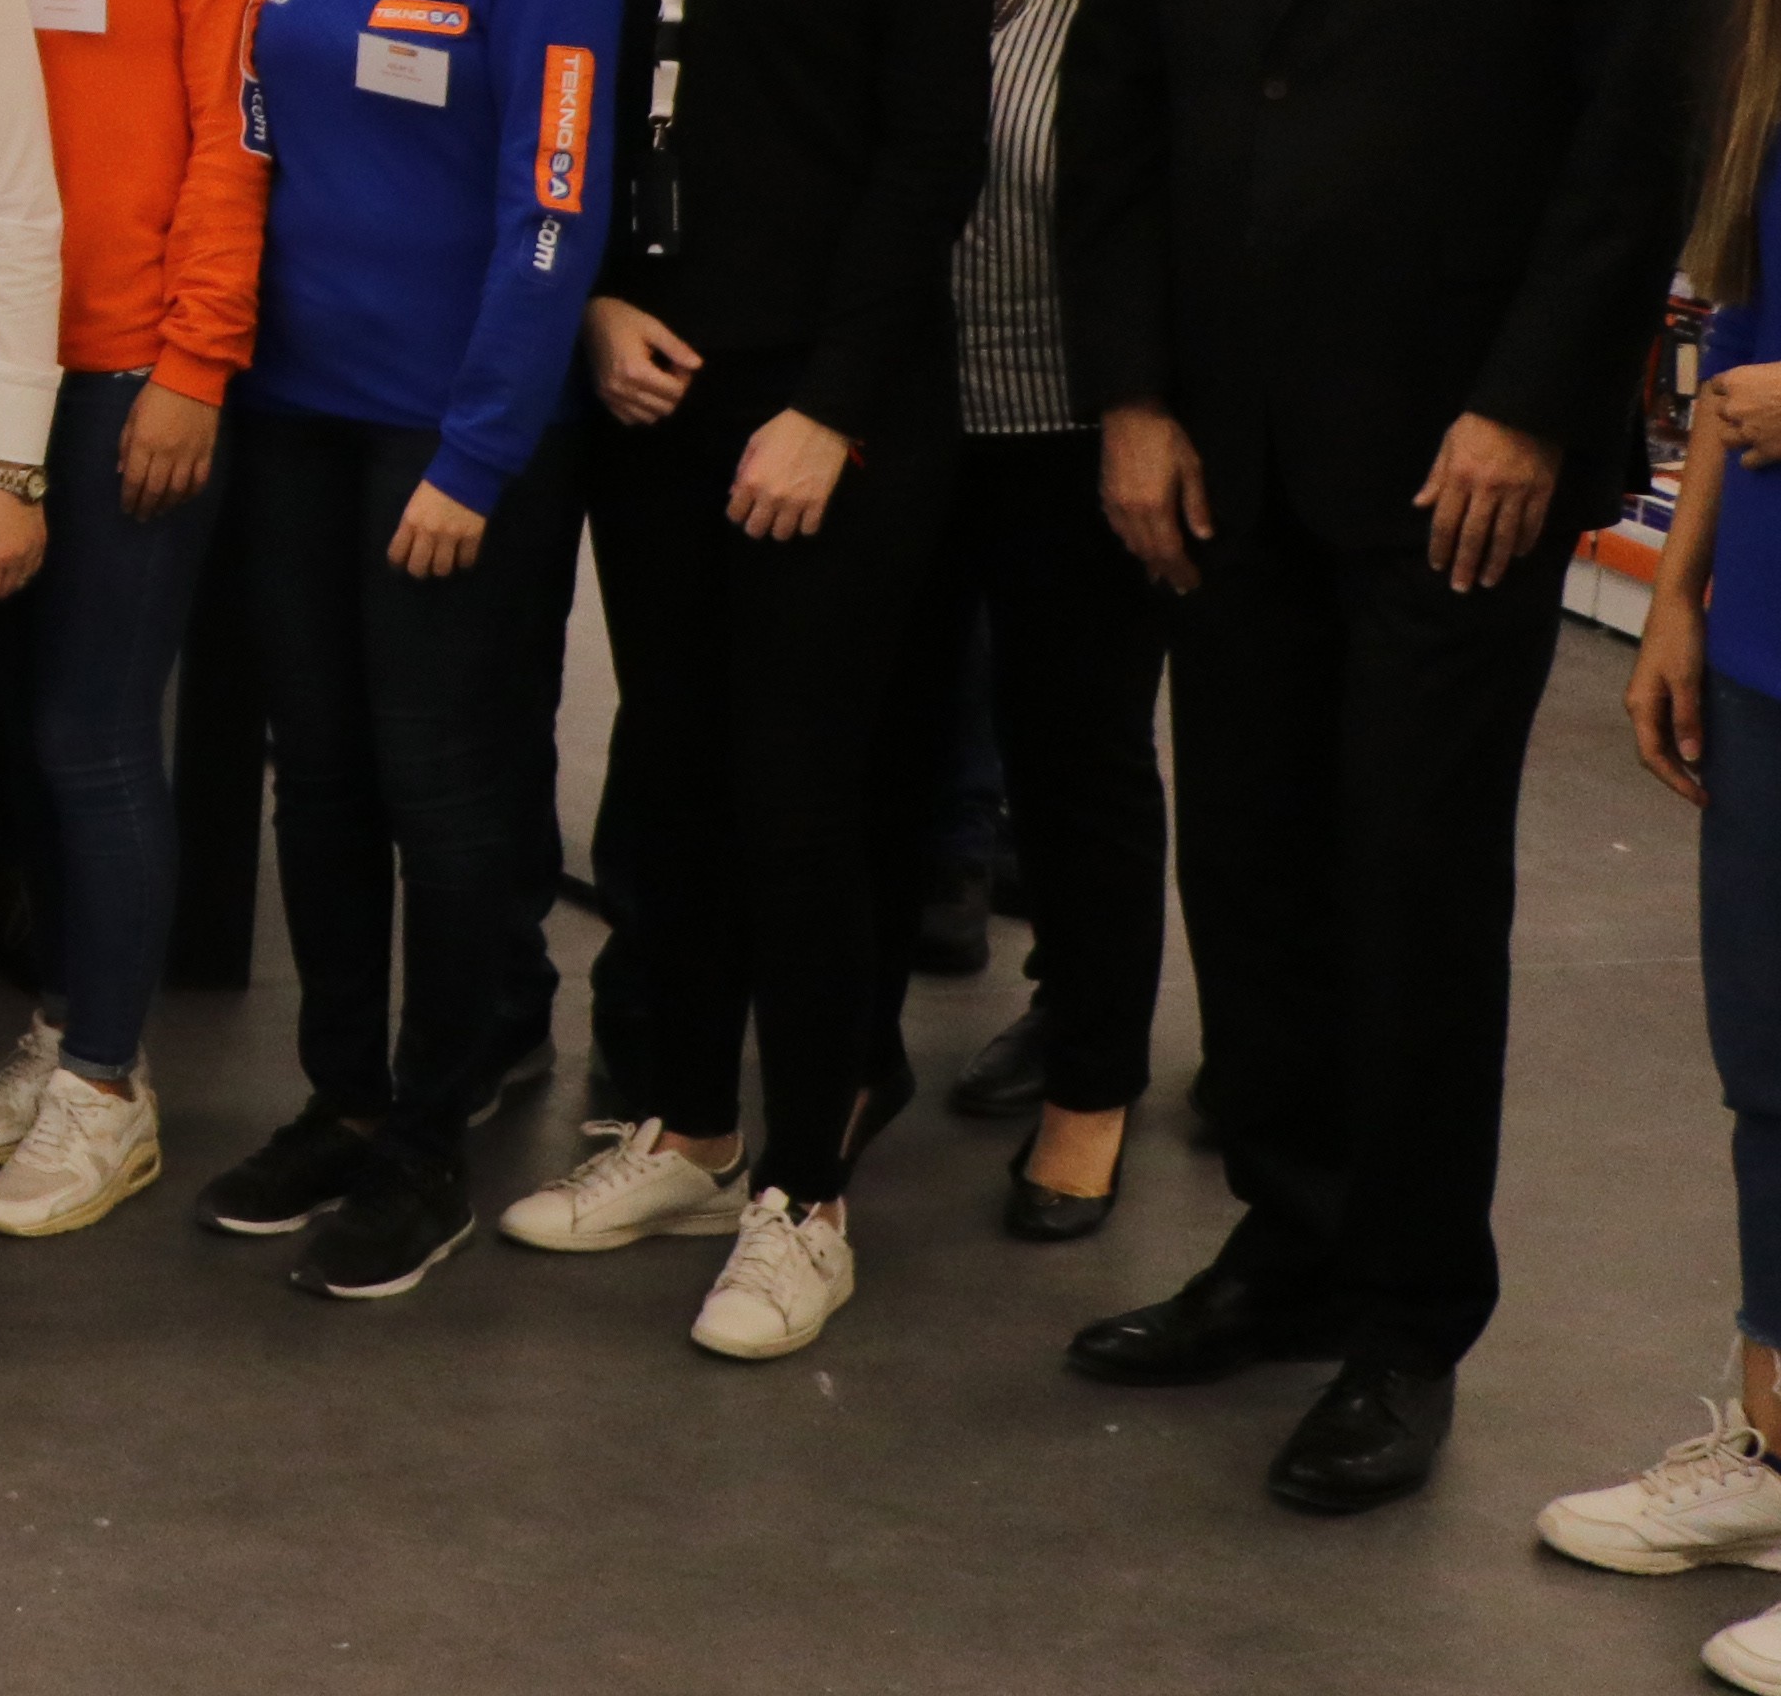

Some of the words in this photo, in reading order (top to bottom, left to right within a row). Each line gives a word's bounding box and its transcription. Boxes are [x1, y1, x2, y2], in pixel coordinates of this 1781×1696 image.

[374, 7, 462, 26] TEKNOSA
[250, 87, 267, 141] .com
[548, 53, 582, 199] TEKNOSA
[532, 213, 563, 273] .com
